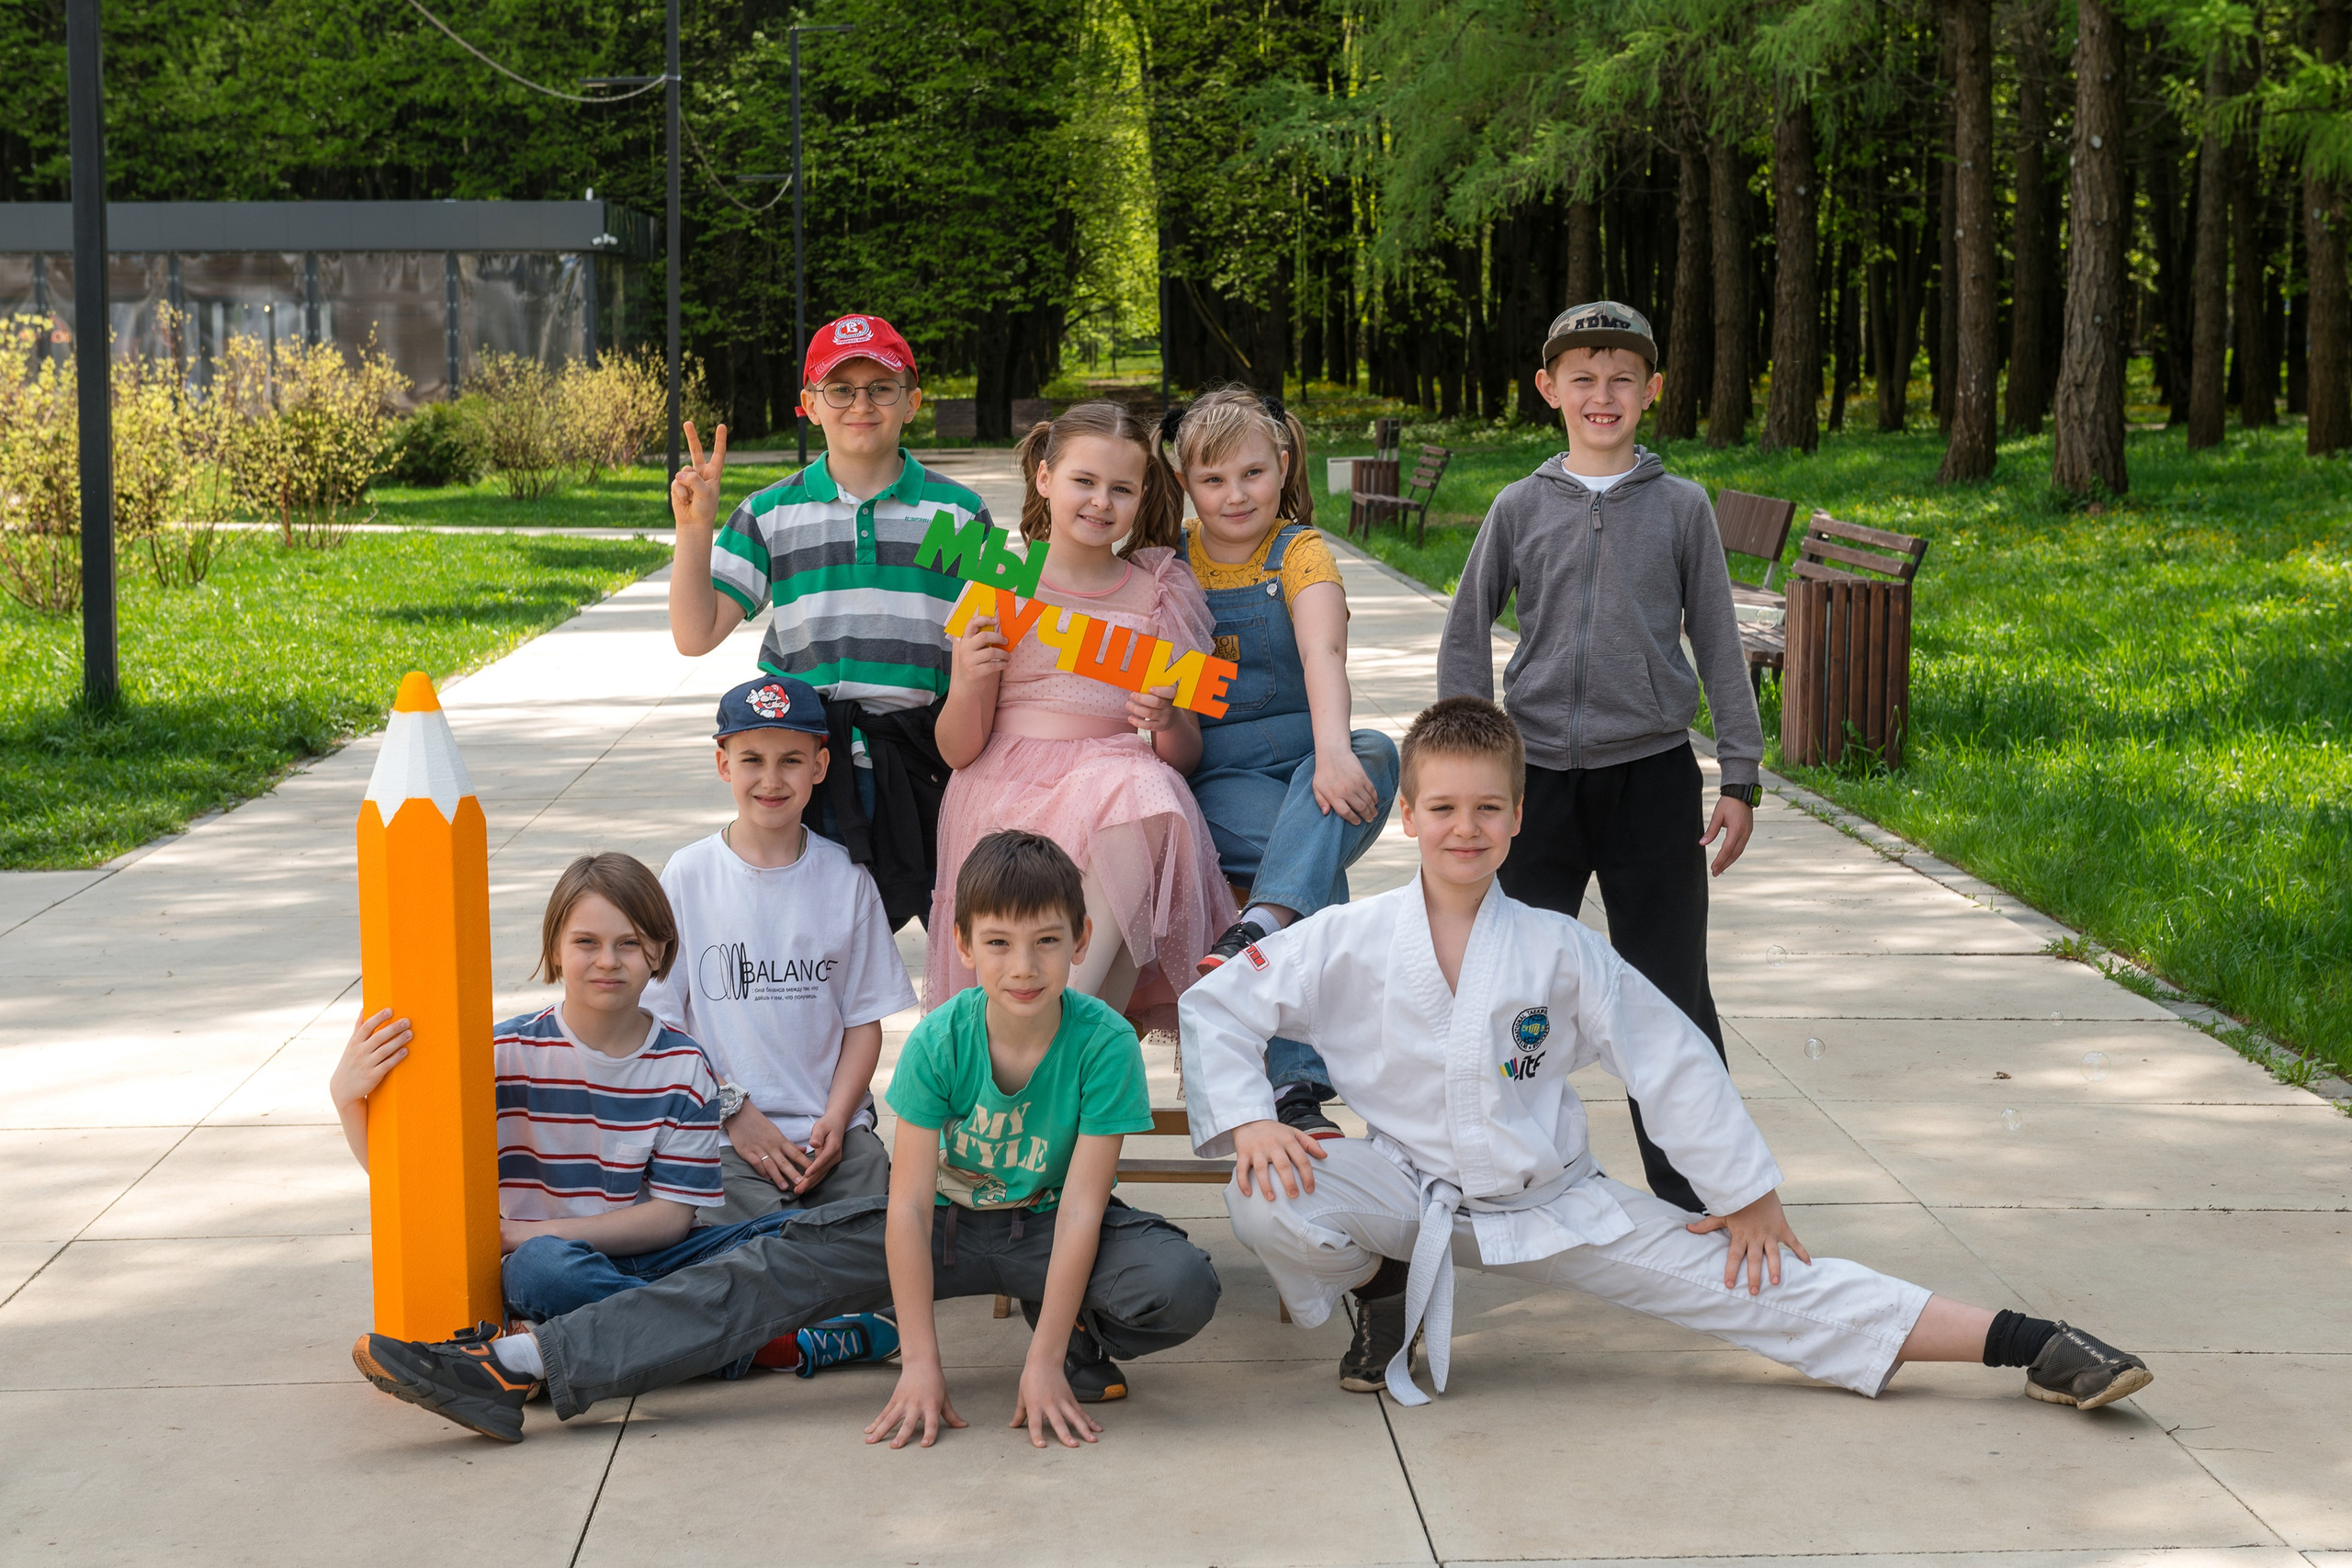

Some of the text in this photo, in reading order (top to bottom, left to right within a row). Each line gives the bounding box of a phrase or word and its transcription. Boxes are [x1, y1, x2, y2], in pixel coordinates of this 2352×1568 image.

[913, 509, 1050, 599] МЫ
[944, 581, 1238, 719] ЛУЧШИЕ
[954, 1131, 1048, 1173] TYLE
[968, 1101, 1031, 1139] MY
